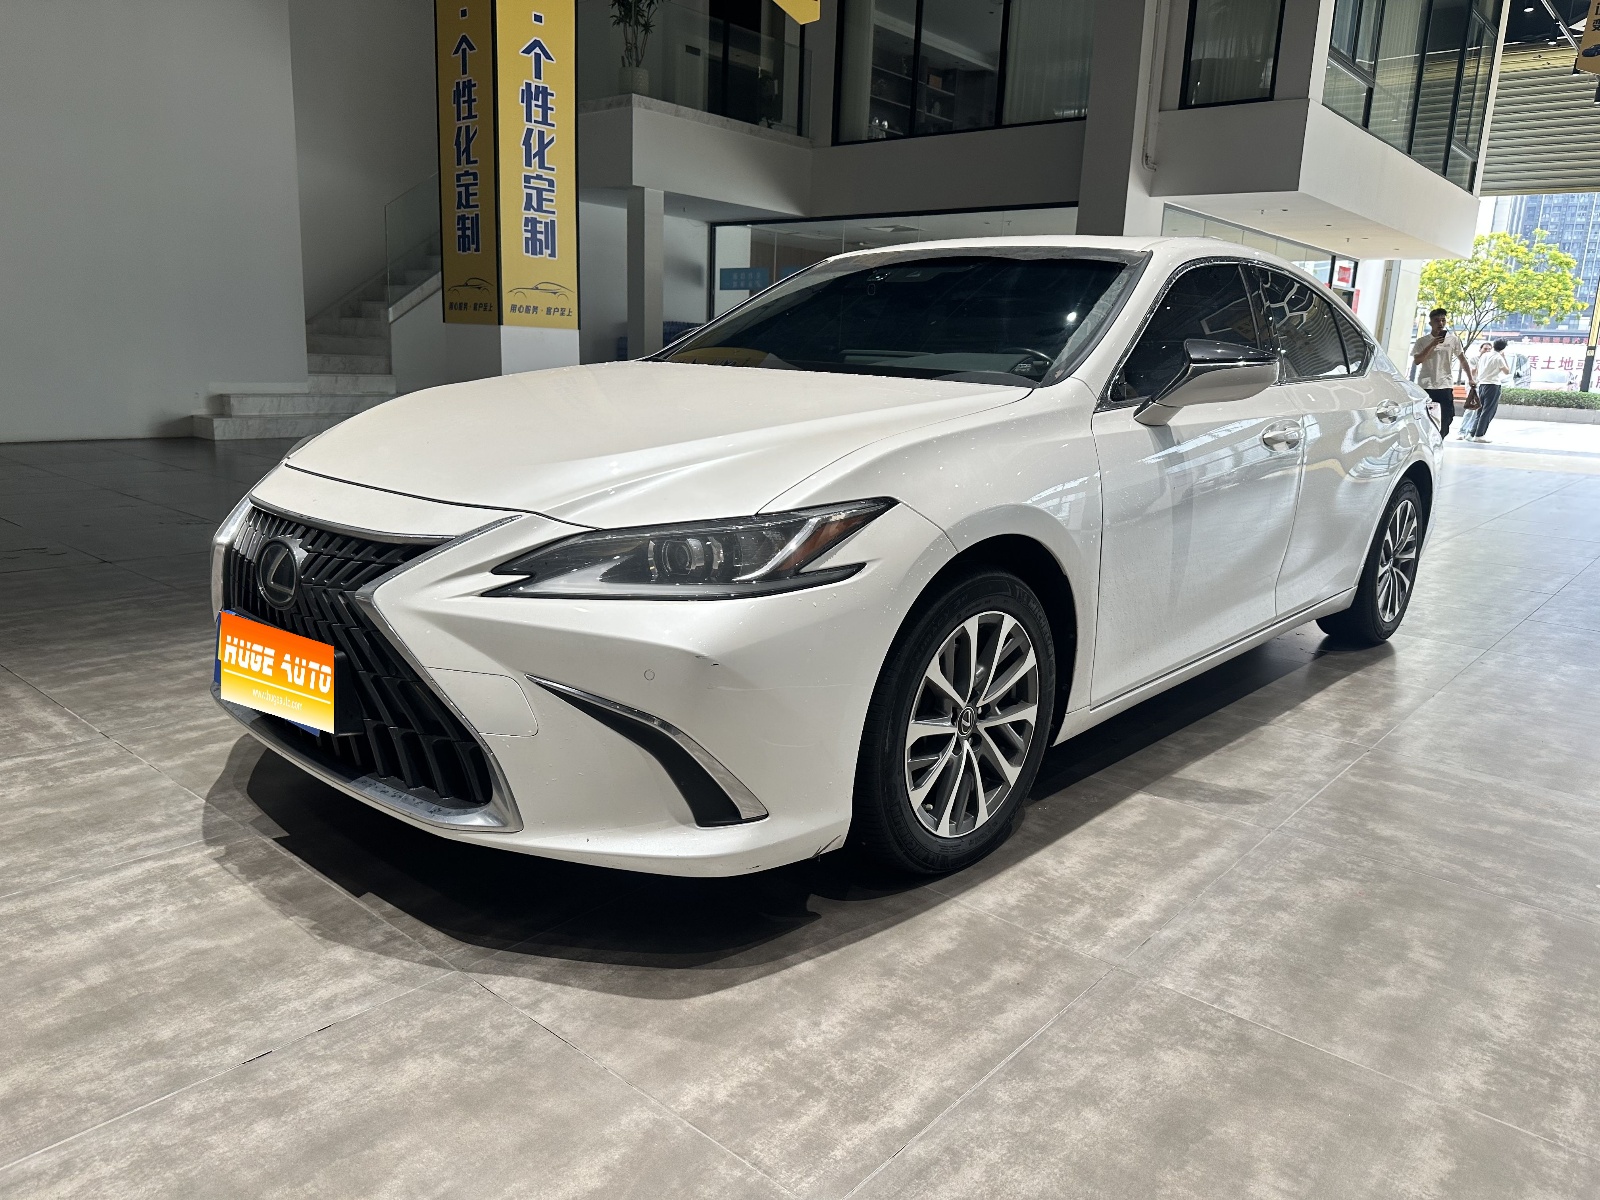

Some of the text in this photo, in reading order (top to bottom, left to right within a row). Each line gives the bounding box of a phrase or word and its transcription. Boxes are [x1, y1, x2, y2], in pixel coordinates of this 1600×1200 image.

[451, 33, 480, 254] 个性化定制
[519, 38, 558, 259] 个性化定制
